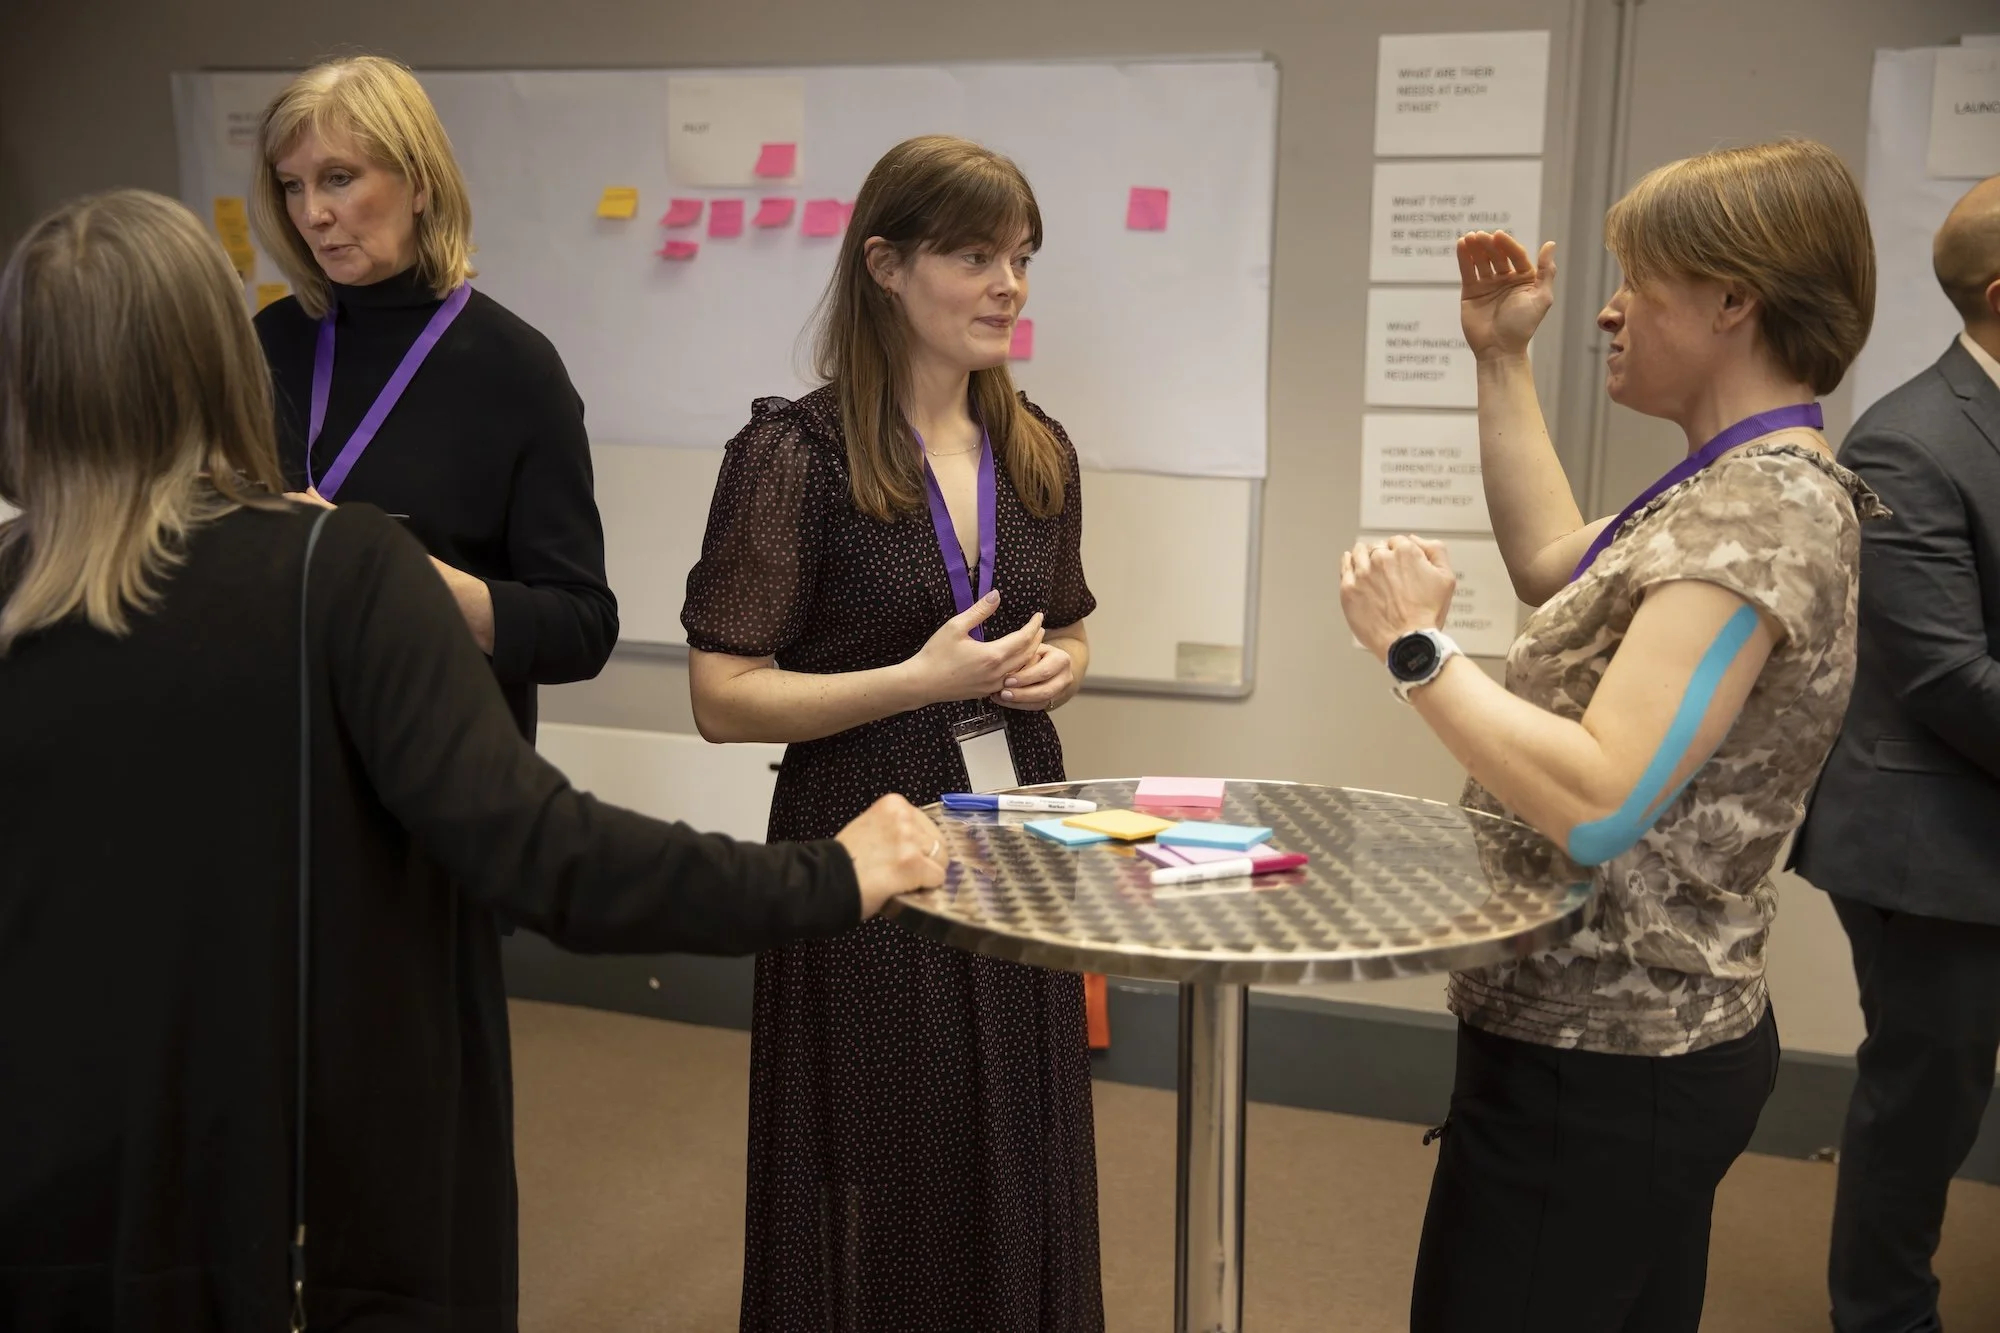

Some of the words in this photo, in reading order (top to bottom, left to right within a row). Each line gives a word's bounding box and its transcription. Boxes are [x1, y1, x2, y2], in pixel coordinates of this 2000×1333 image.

[1398, 68, 1433, 79] WHAT
[1435, 67, 1457, 79] ARE
[1397, 85, 1434, 97] NEEDS
[1438, 84, 1452, 96] AT
[1454, 84, 1488, 97] EACH
[1397, 101, 1441, 113] STAGE?
[682, 122, 711, 134] PILOT
[1392, 195, 1426, 206] WHAT
[1391, 211, 1464, 223] INVESTMENT
[1386, 320, 1420, 331] WHAT
[1385, 354, 1436, 365] SUPPORT
[1410, 447, 1435, 457] CAN
